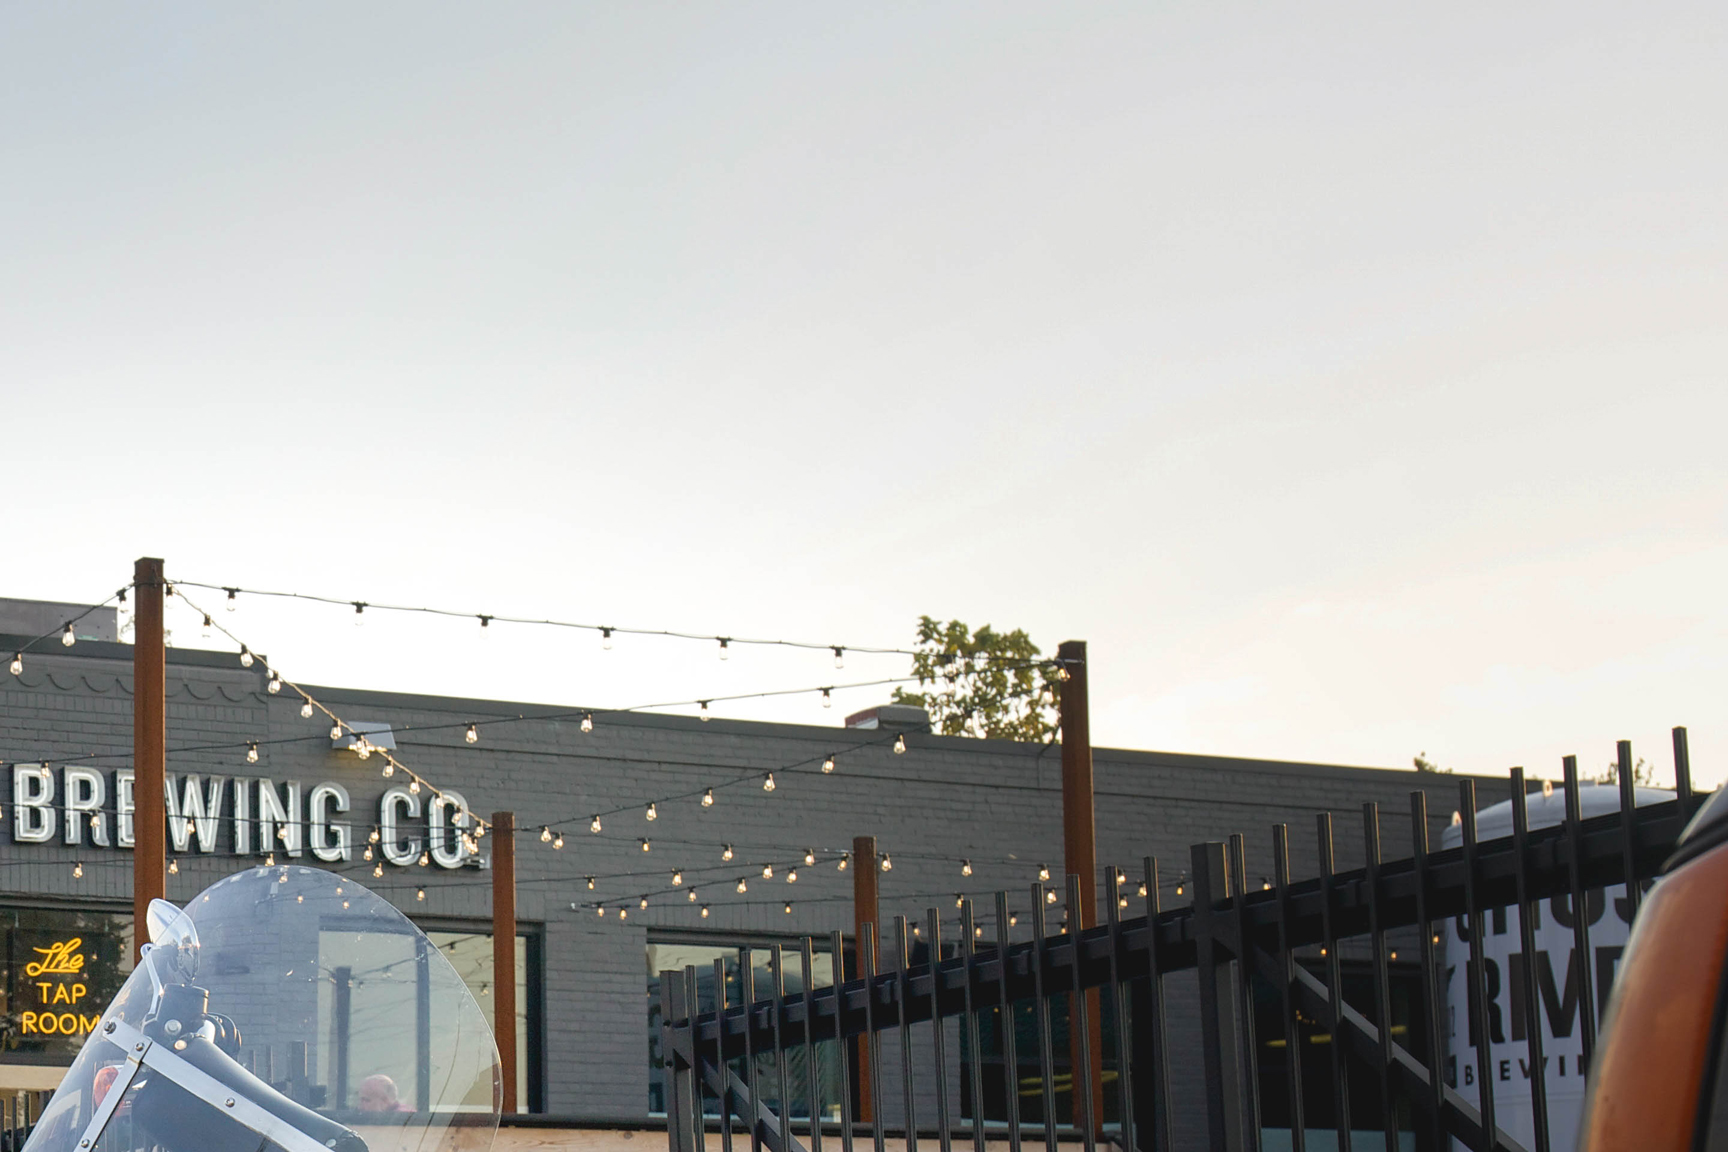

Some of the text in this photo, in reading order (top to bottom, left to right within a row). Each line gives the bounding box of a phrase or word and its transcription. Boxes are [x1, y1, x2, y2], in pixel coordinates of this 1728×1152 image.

[13, 763, 352, 861] BREWING
[26, 937, 84, 976] The
[36, 982, 86, 1004] TAP
[22, 1011, 100, 1035] ROOM
